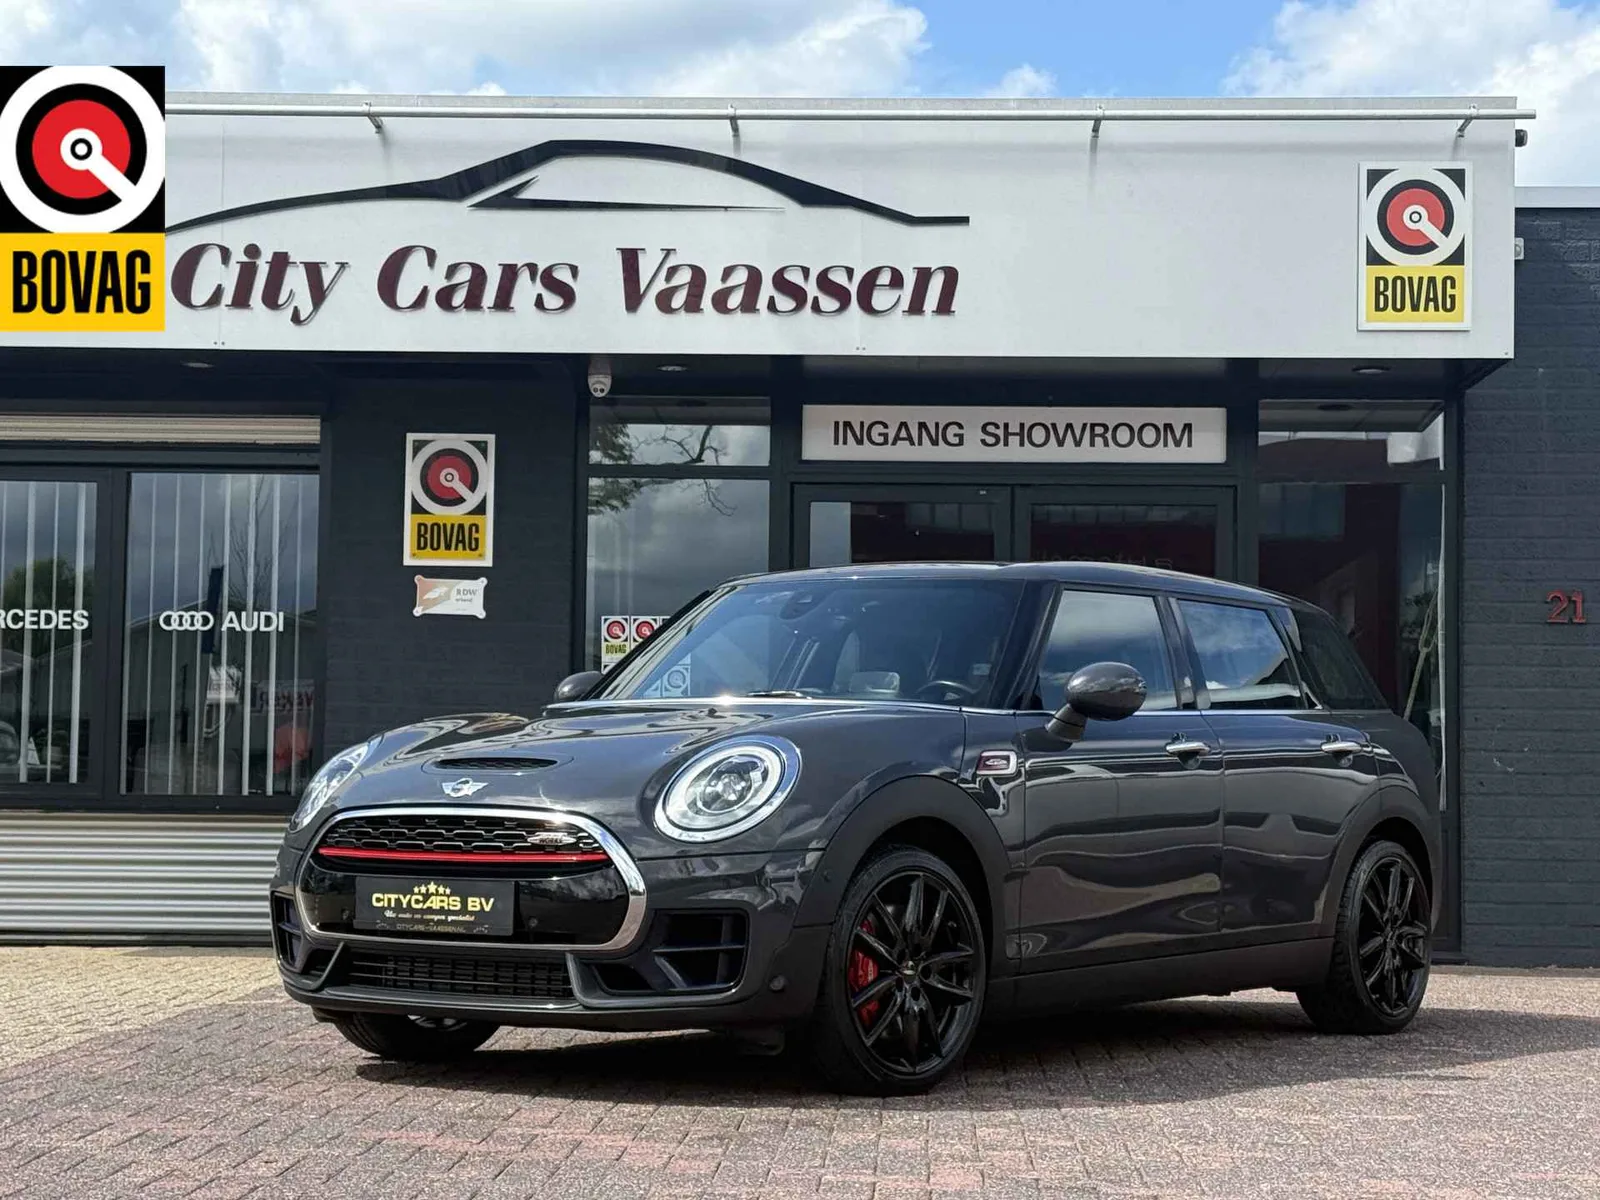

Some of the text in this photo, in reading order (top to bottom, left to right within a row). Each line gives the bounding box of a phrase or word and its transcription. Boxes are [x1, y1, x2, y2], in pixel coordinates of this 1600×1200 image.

[171, 243, 960, 325] City Cars Vaassen
[1375, 275, 1456, 312] BOVAG
[833, 420, 1193, 448] INGANG SHOWROOM
[416, 523, 479, 551] BOVAG
[1546, 590, 1586, 623] 21
[222, 611, 284, 632] AUDI
[605, 643, 627, 653] BOVAG
[371, 893, 494, 912] CITYCARS BV
